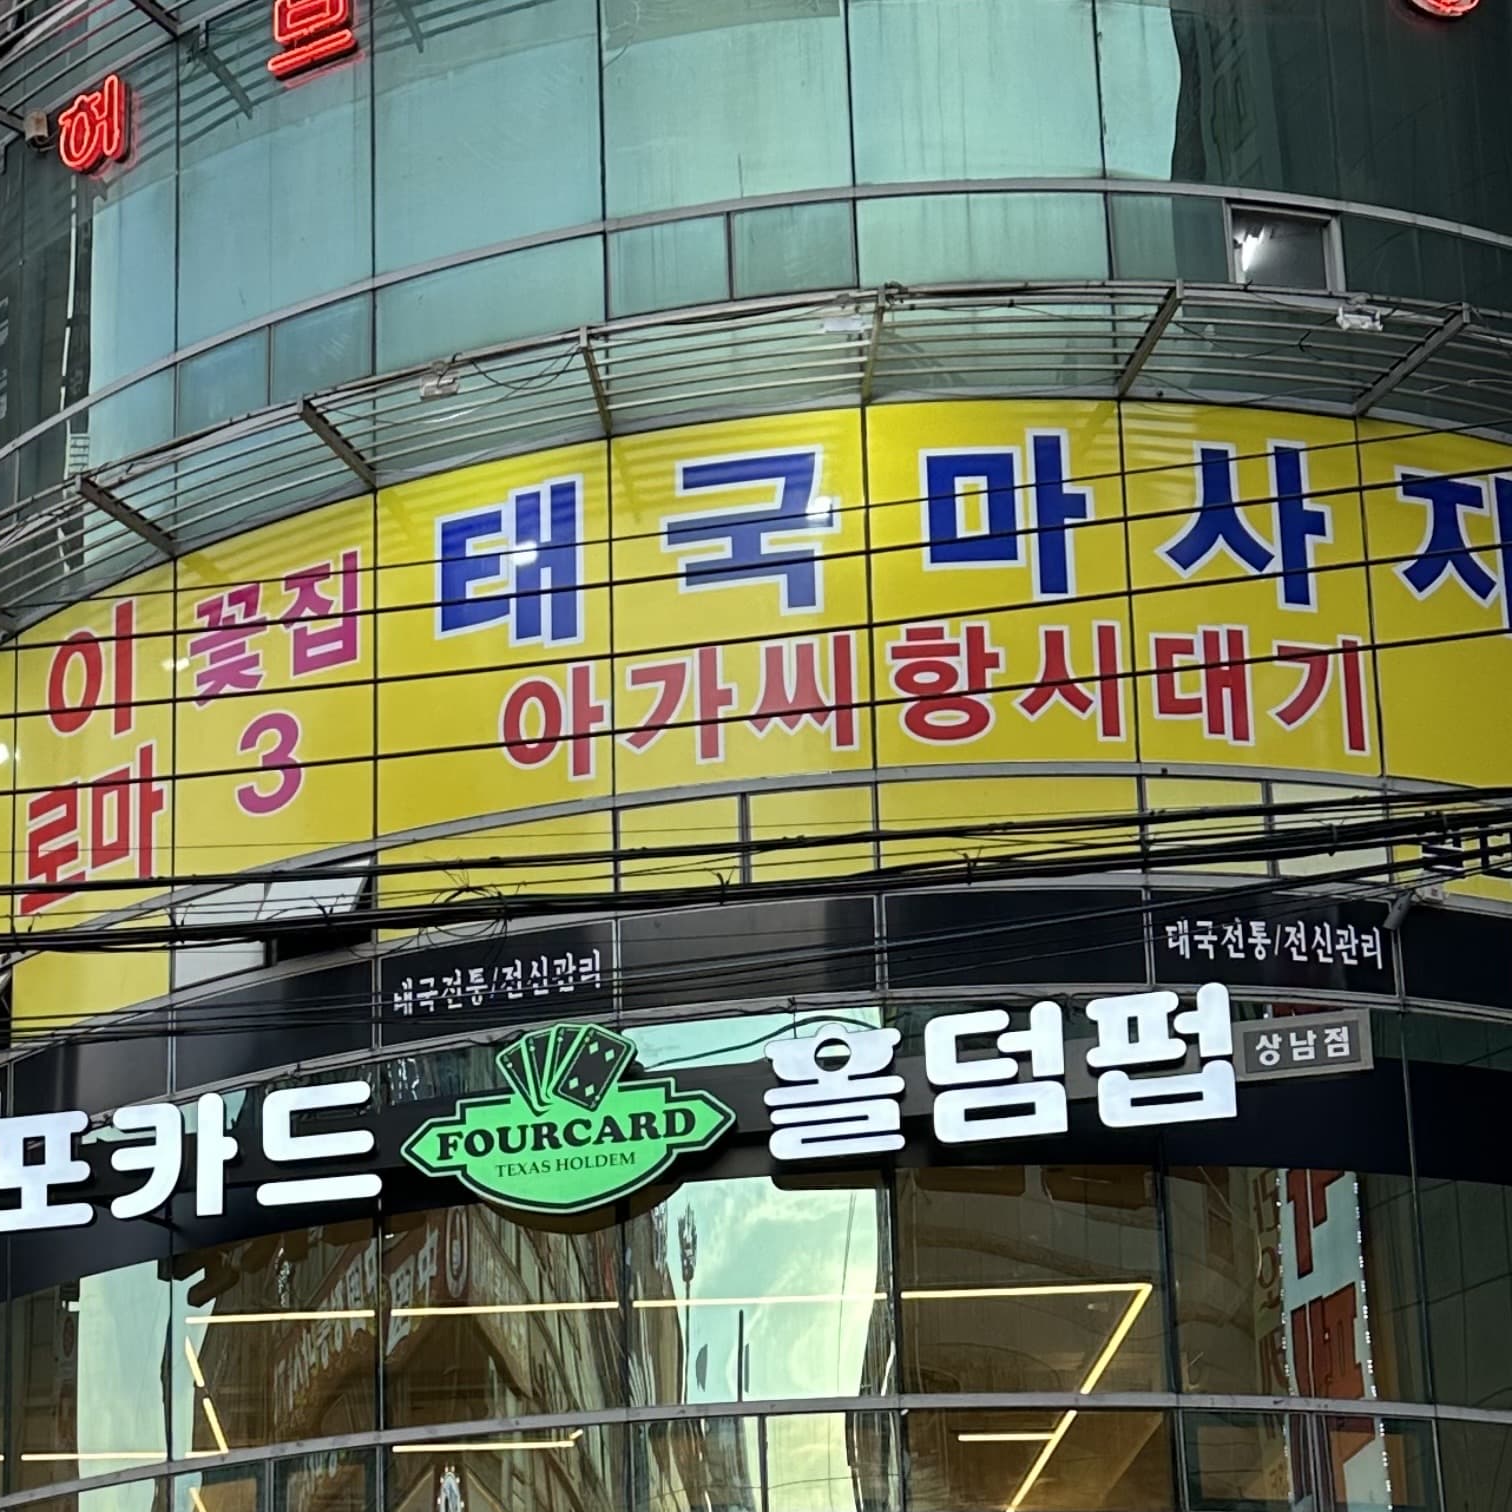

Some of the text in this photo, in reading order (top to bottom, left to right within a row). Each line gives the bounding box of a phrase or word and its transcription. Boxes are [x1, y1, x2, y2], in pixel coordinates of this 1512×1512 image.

[188, 549, 362, 709] 꽃집
[234, 710, 305, 816] 3
[763, 981, 1237, 1160] 홀덤펍
[1255, 1026, 1351, 1066] 상남점
[435, 1103, 697, 1162] FOURCARD
[495, 1151, 637, 1179] TEXAS HOLDEM
